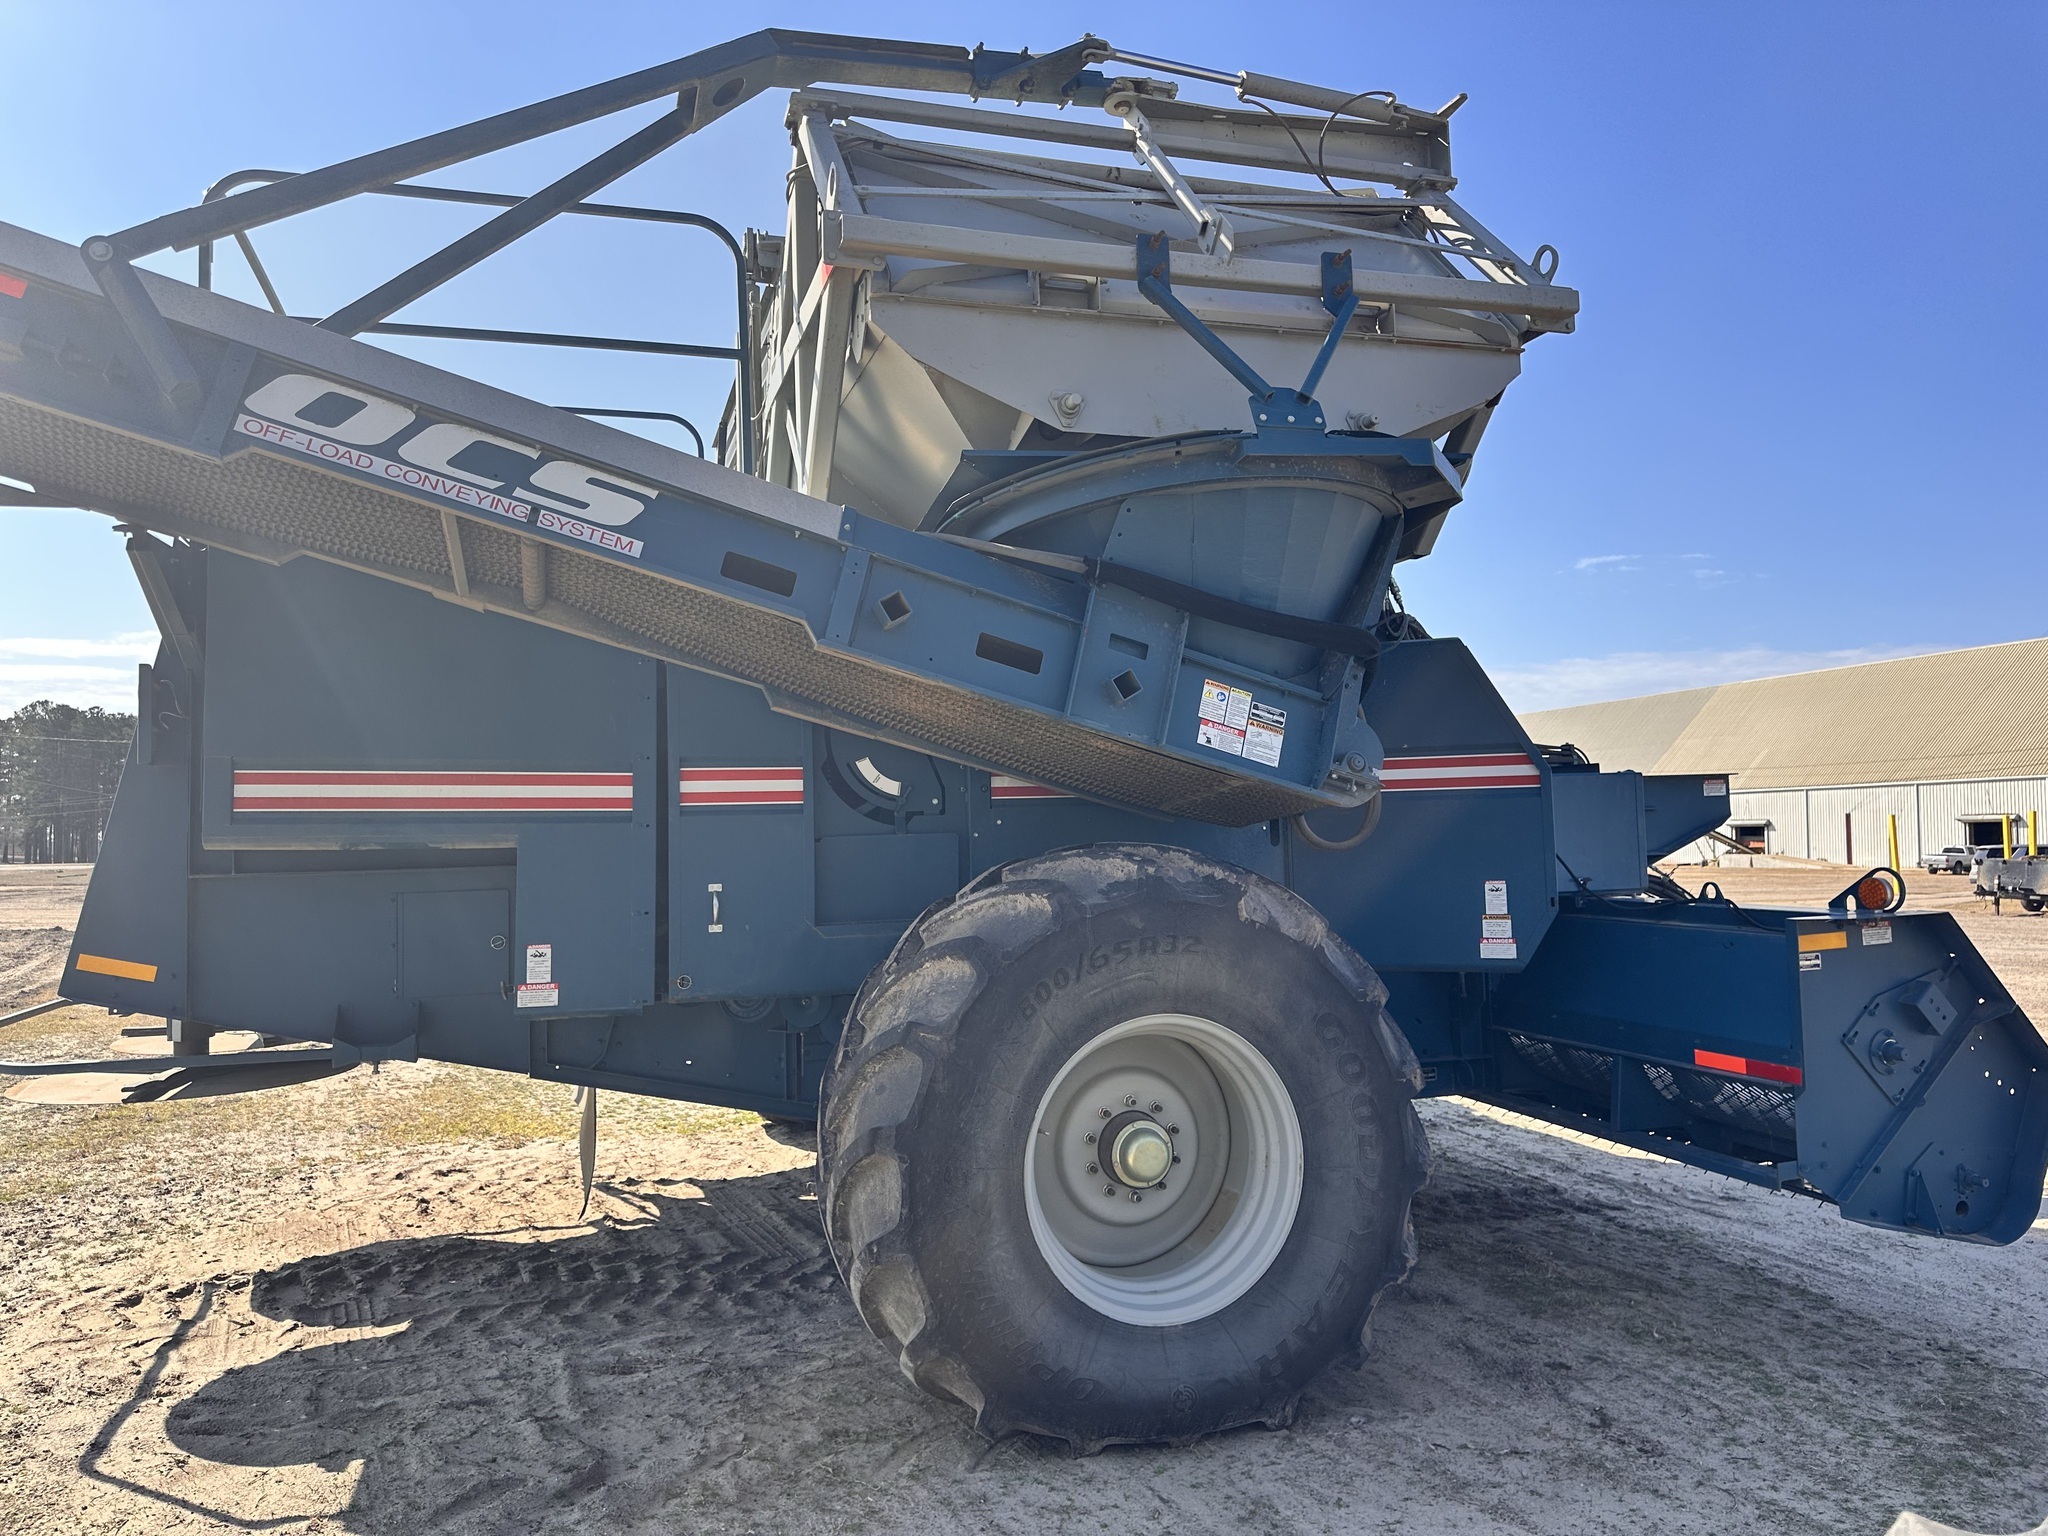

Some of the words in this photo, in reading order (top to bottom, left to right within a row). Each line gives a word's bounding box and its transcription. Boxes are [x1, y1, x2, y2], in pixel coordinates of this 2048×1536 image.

[243, 418, 374, 470] OFF-LOAD
[384, 464, 530, 521] CONVEYING
[539, 512, 635, 554] SYSTEM
[244, 374, 659, 526] OCS
[1214, 723, 1239, 735] DANGER
[1256, 722, 1284, 735] WARNING
